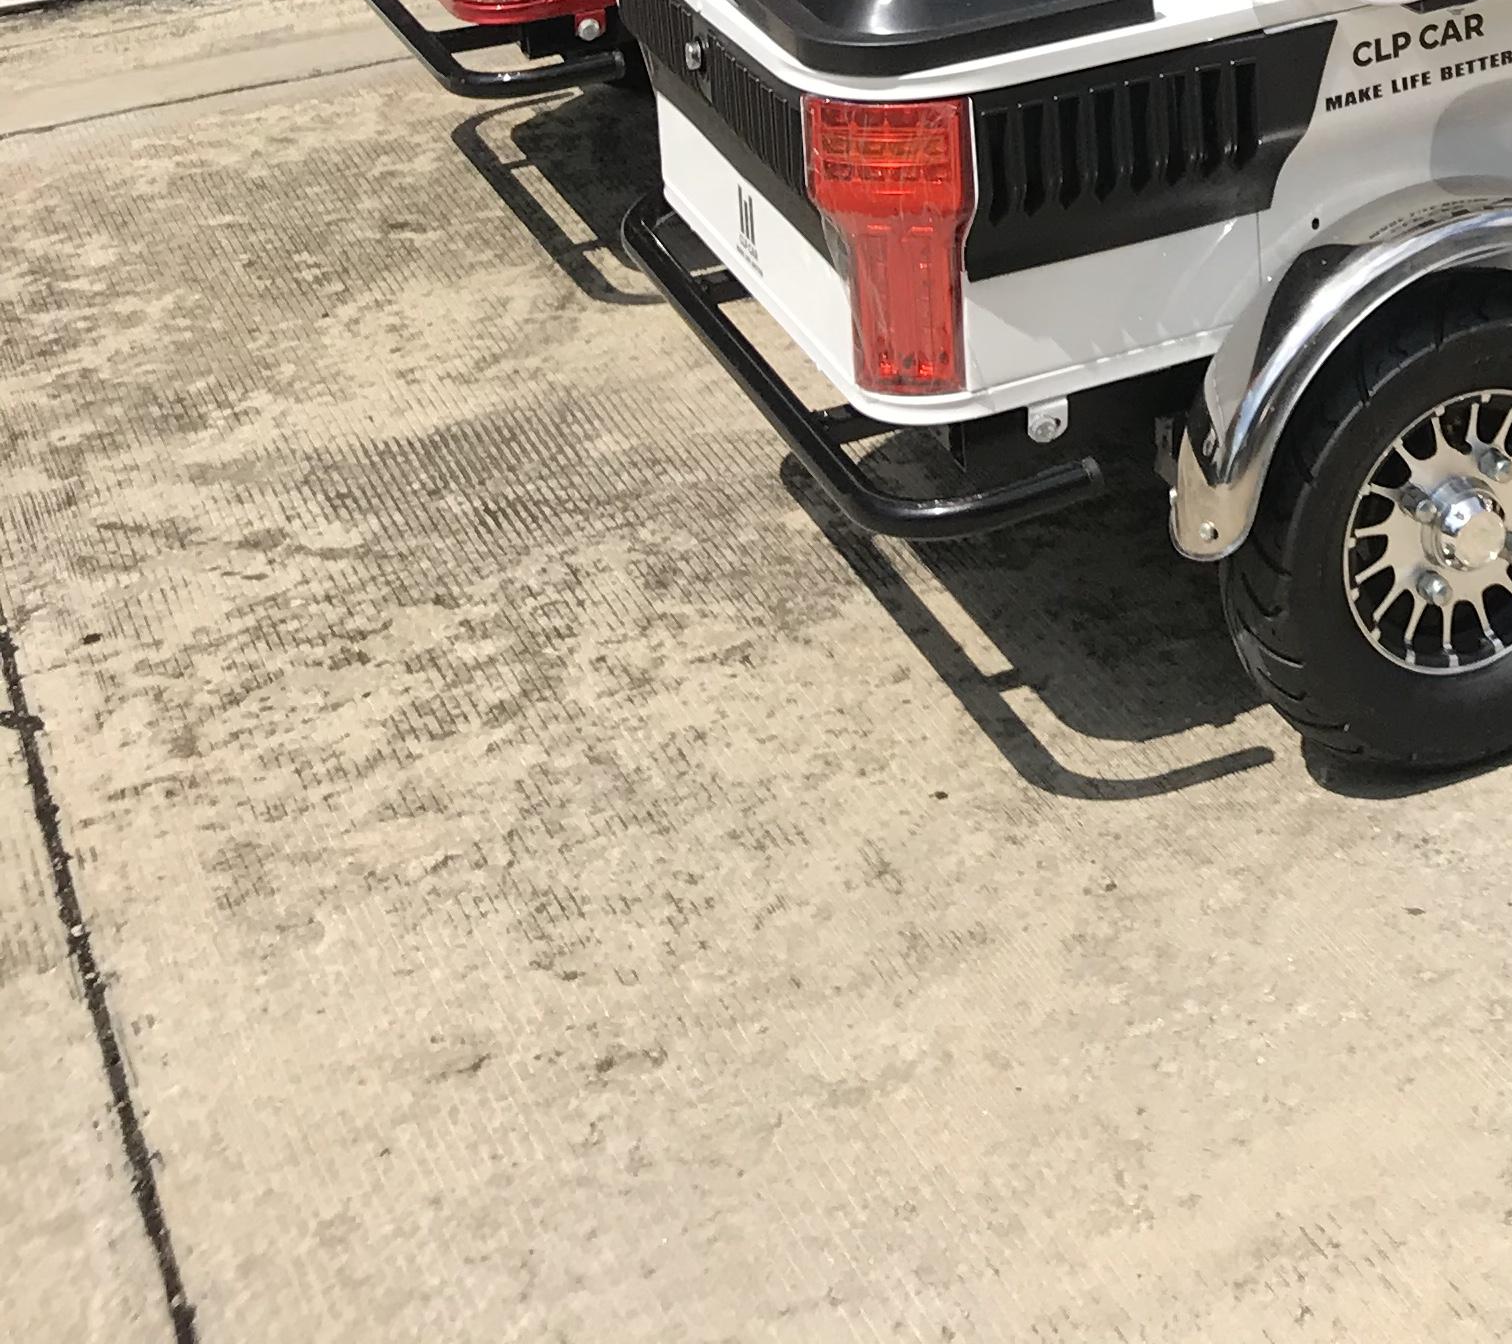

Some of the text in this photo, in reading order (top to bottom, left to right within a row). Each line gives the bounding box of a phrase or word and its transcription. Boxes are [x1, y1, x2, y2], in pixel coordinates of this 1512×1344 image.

[1353, 13, 1485, 67] CLP CAR
[1325, 84, 1383, 112] MAKE
[1391, 71, 1431, 94] LIFE
